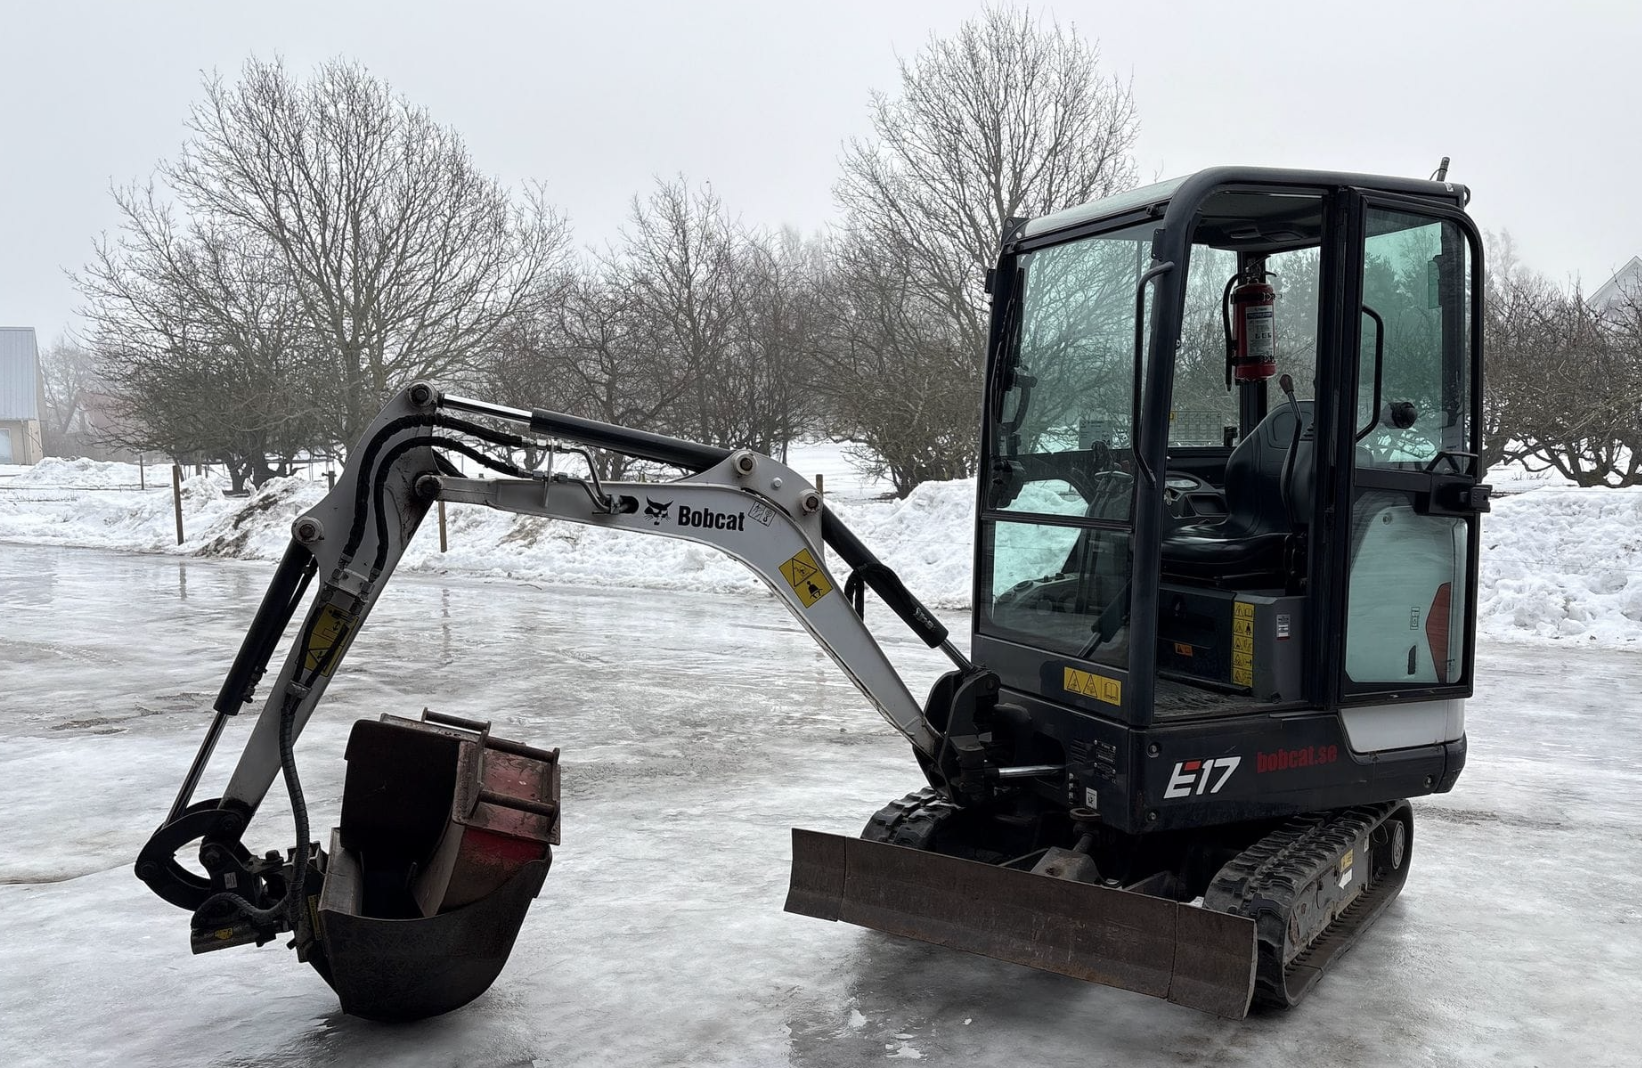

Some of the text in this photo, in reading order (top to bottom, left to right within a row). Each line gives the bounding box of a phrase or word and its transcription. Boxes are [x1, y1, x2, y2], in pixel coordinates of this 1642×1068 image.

[678, 505, 745, 531] Bobcat
[1257, 745, 1338, 773] bobcat.se
[1163, 756, 1242, 799] E17
